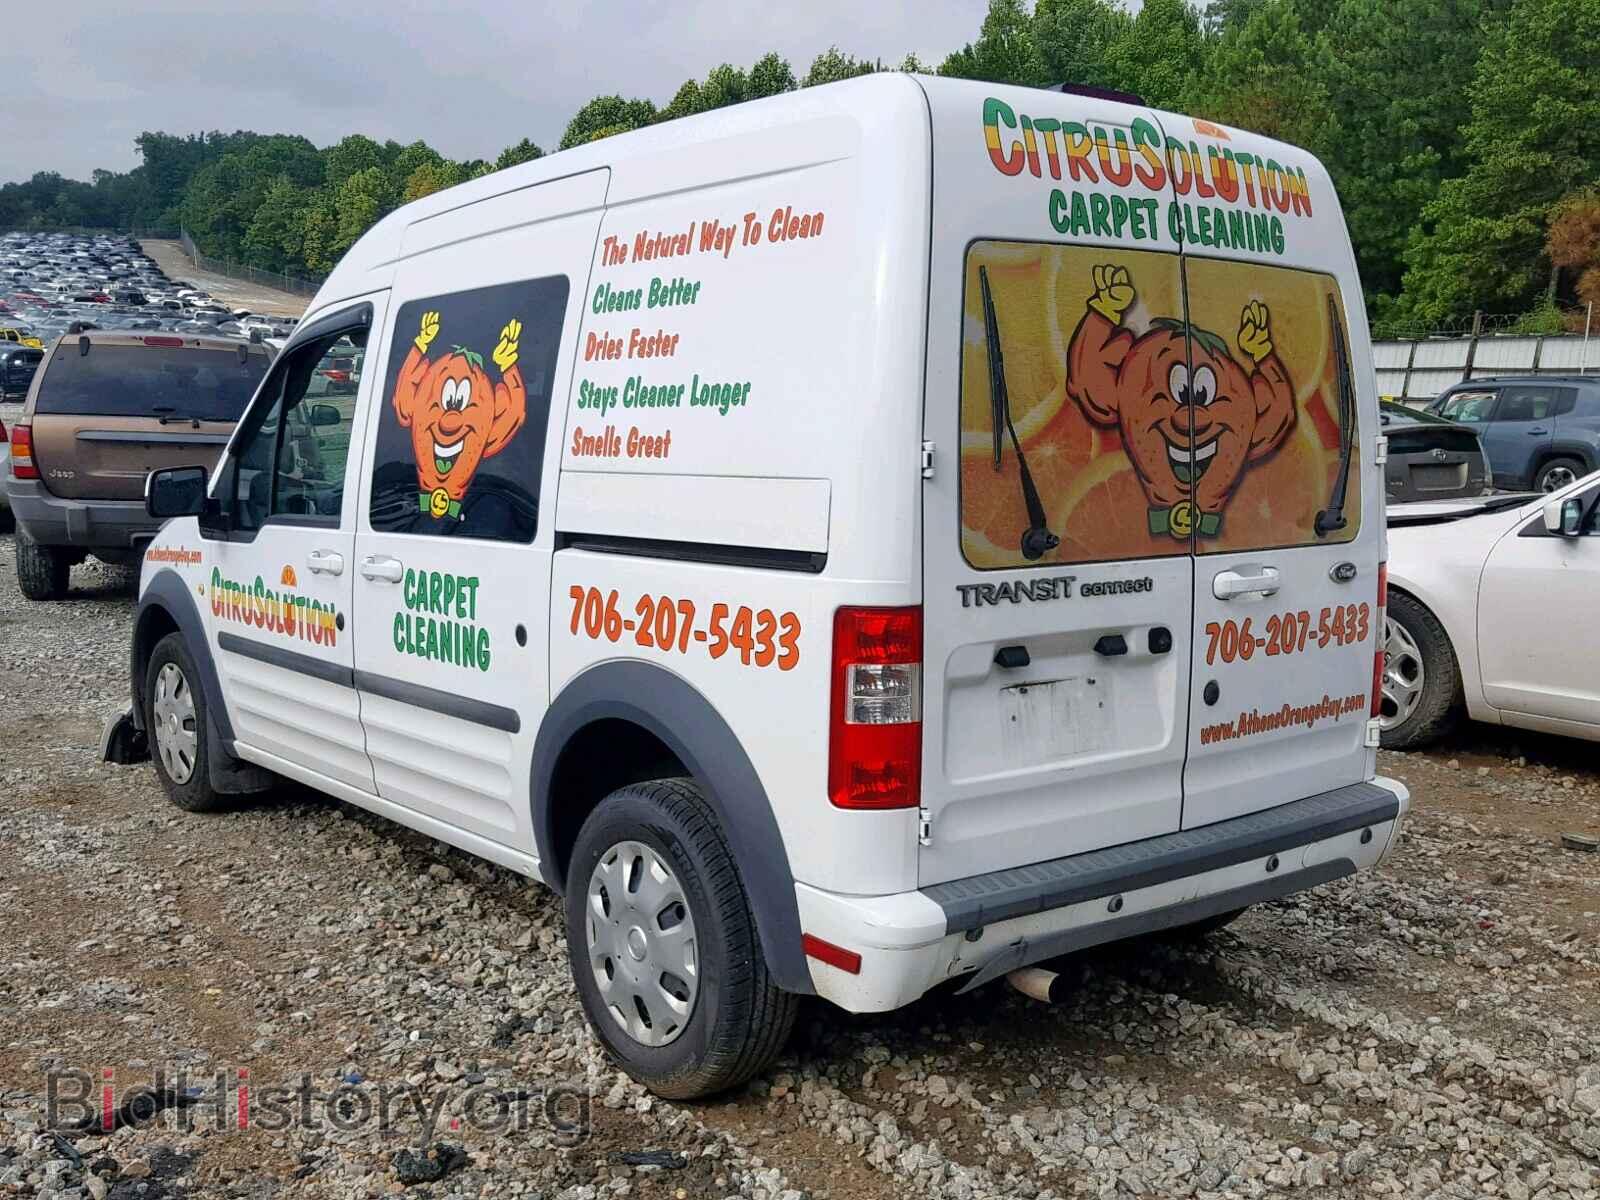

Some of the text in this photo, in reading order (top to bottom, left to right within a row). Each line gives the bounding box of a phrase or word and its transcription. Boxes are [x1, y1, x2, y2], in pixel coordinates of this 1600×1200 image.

[602, 205, 824, 266] The Natural Way To Clean
[1049, 189, 1285, 255] CARPET CLEANING
[592, 277, 700, 314] Cleans Better
[584, 328, 679, 361] Dries Faster
[577, 374, 751, 417] Stays Cleaner Longer
[571, 425, 671, 458] Smells Great
[404, 568, 480, 621] CARPET
[956, 576, 1153, 607] TRANSIT connect
[393, 612, 490, 672] CLEANING
[570, 585, 801, 671] 706-207-5433
[1206, 602, 1369, 666] 706-207-5433
